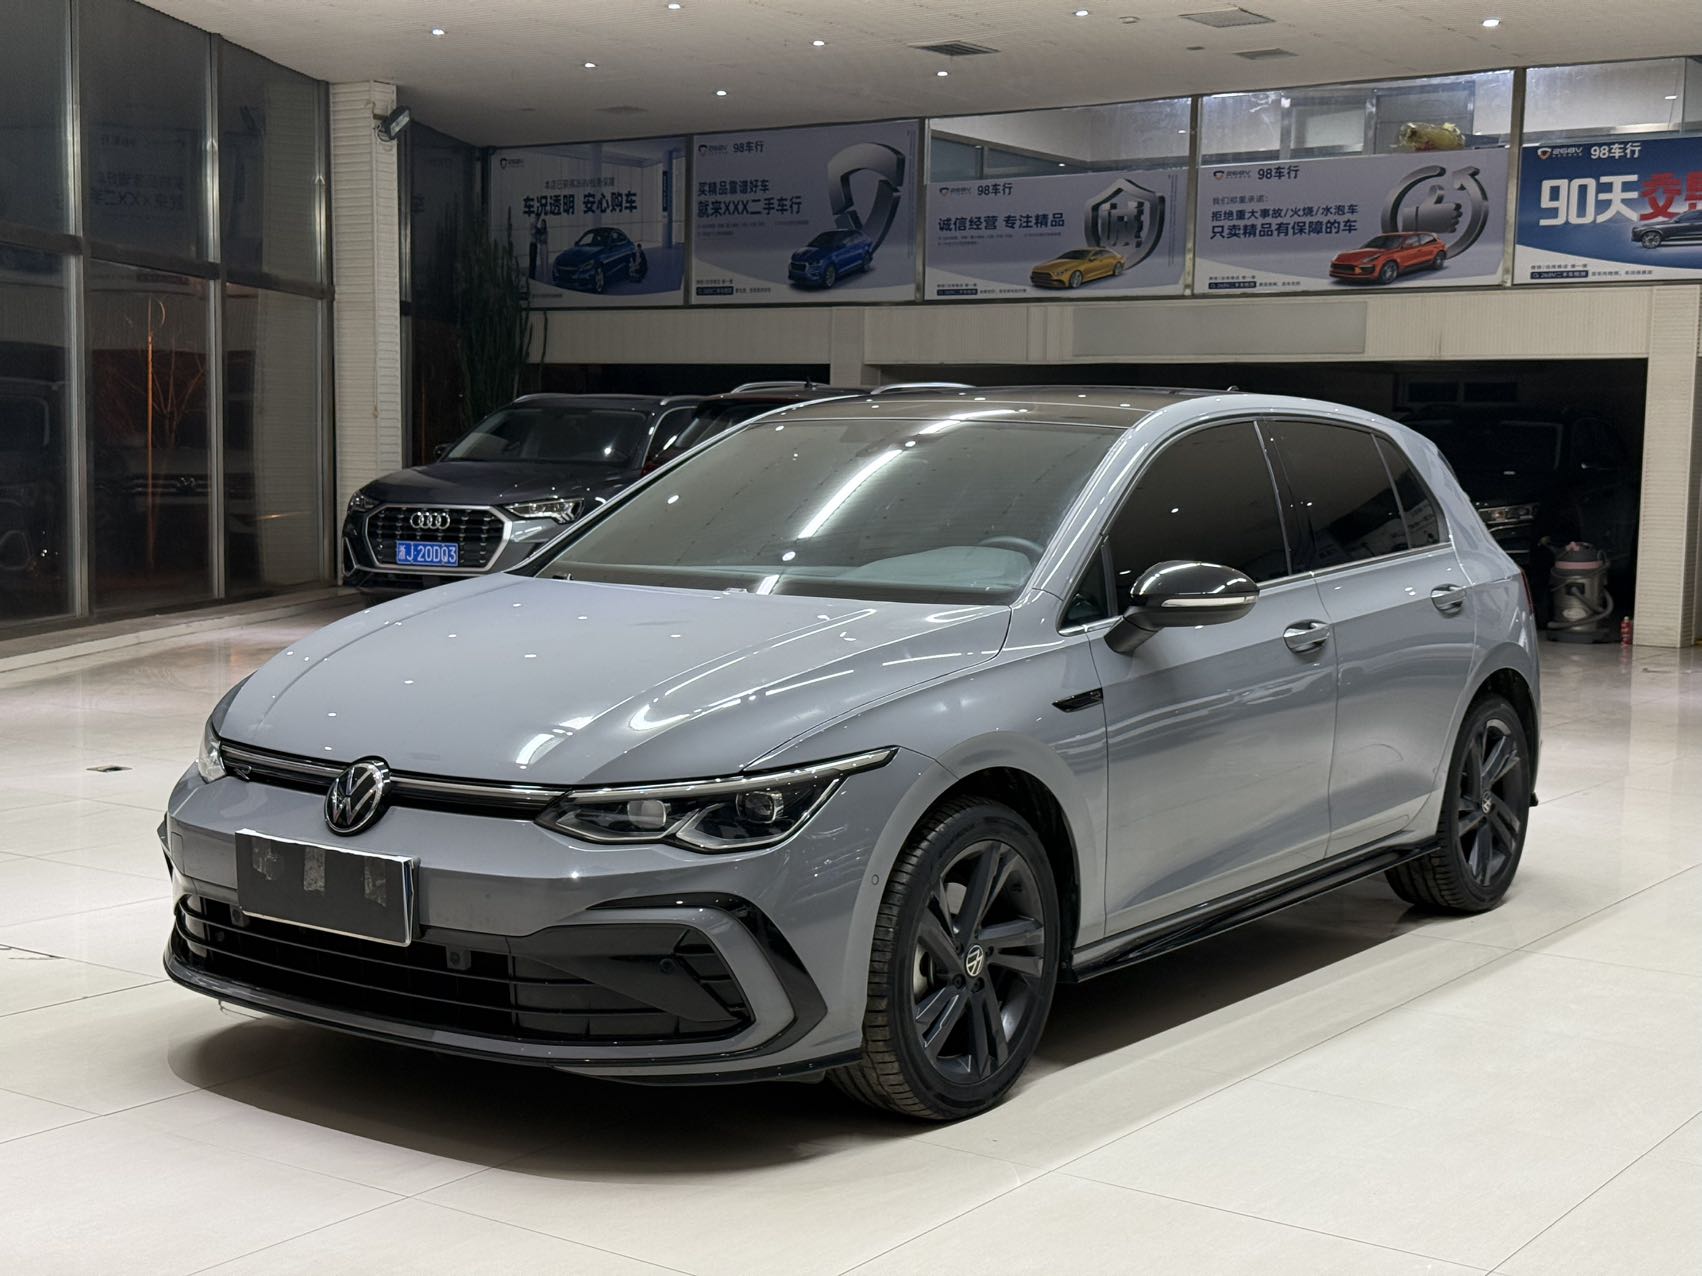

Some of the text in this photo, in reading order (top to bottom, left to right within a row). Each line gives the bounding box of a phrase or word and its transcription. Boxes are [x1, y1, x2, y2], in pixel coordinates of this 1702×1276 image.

[733, 140, 765, 154] 98车行
[1590, 143, 1641, 160] 98车行
[1257, 165, 1300, 181] 98车行
[697, 179, 769, 197] 买精品靠谱好车
[977, 182, 1013, 197] 98车行
[523, 193, 575, 217] 车况透明
[583, 190, 638, 214] 安心购车
[697, 196, 802, 218] 就来XXX二手车行
[938, 212, 1065, 232] 诚信经营 专注精品
[1211, 204, 1359, 222] 拒绝重大事故/火烧/水泡车
[1210, 219, 1358, 240] 只卖精品有保障的车
